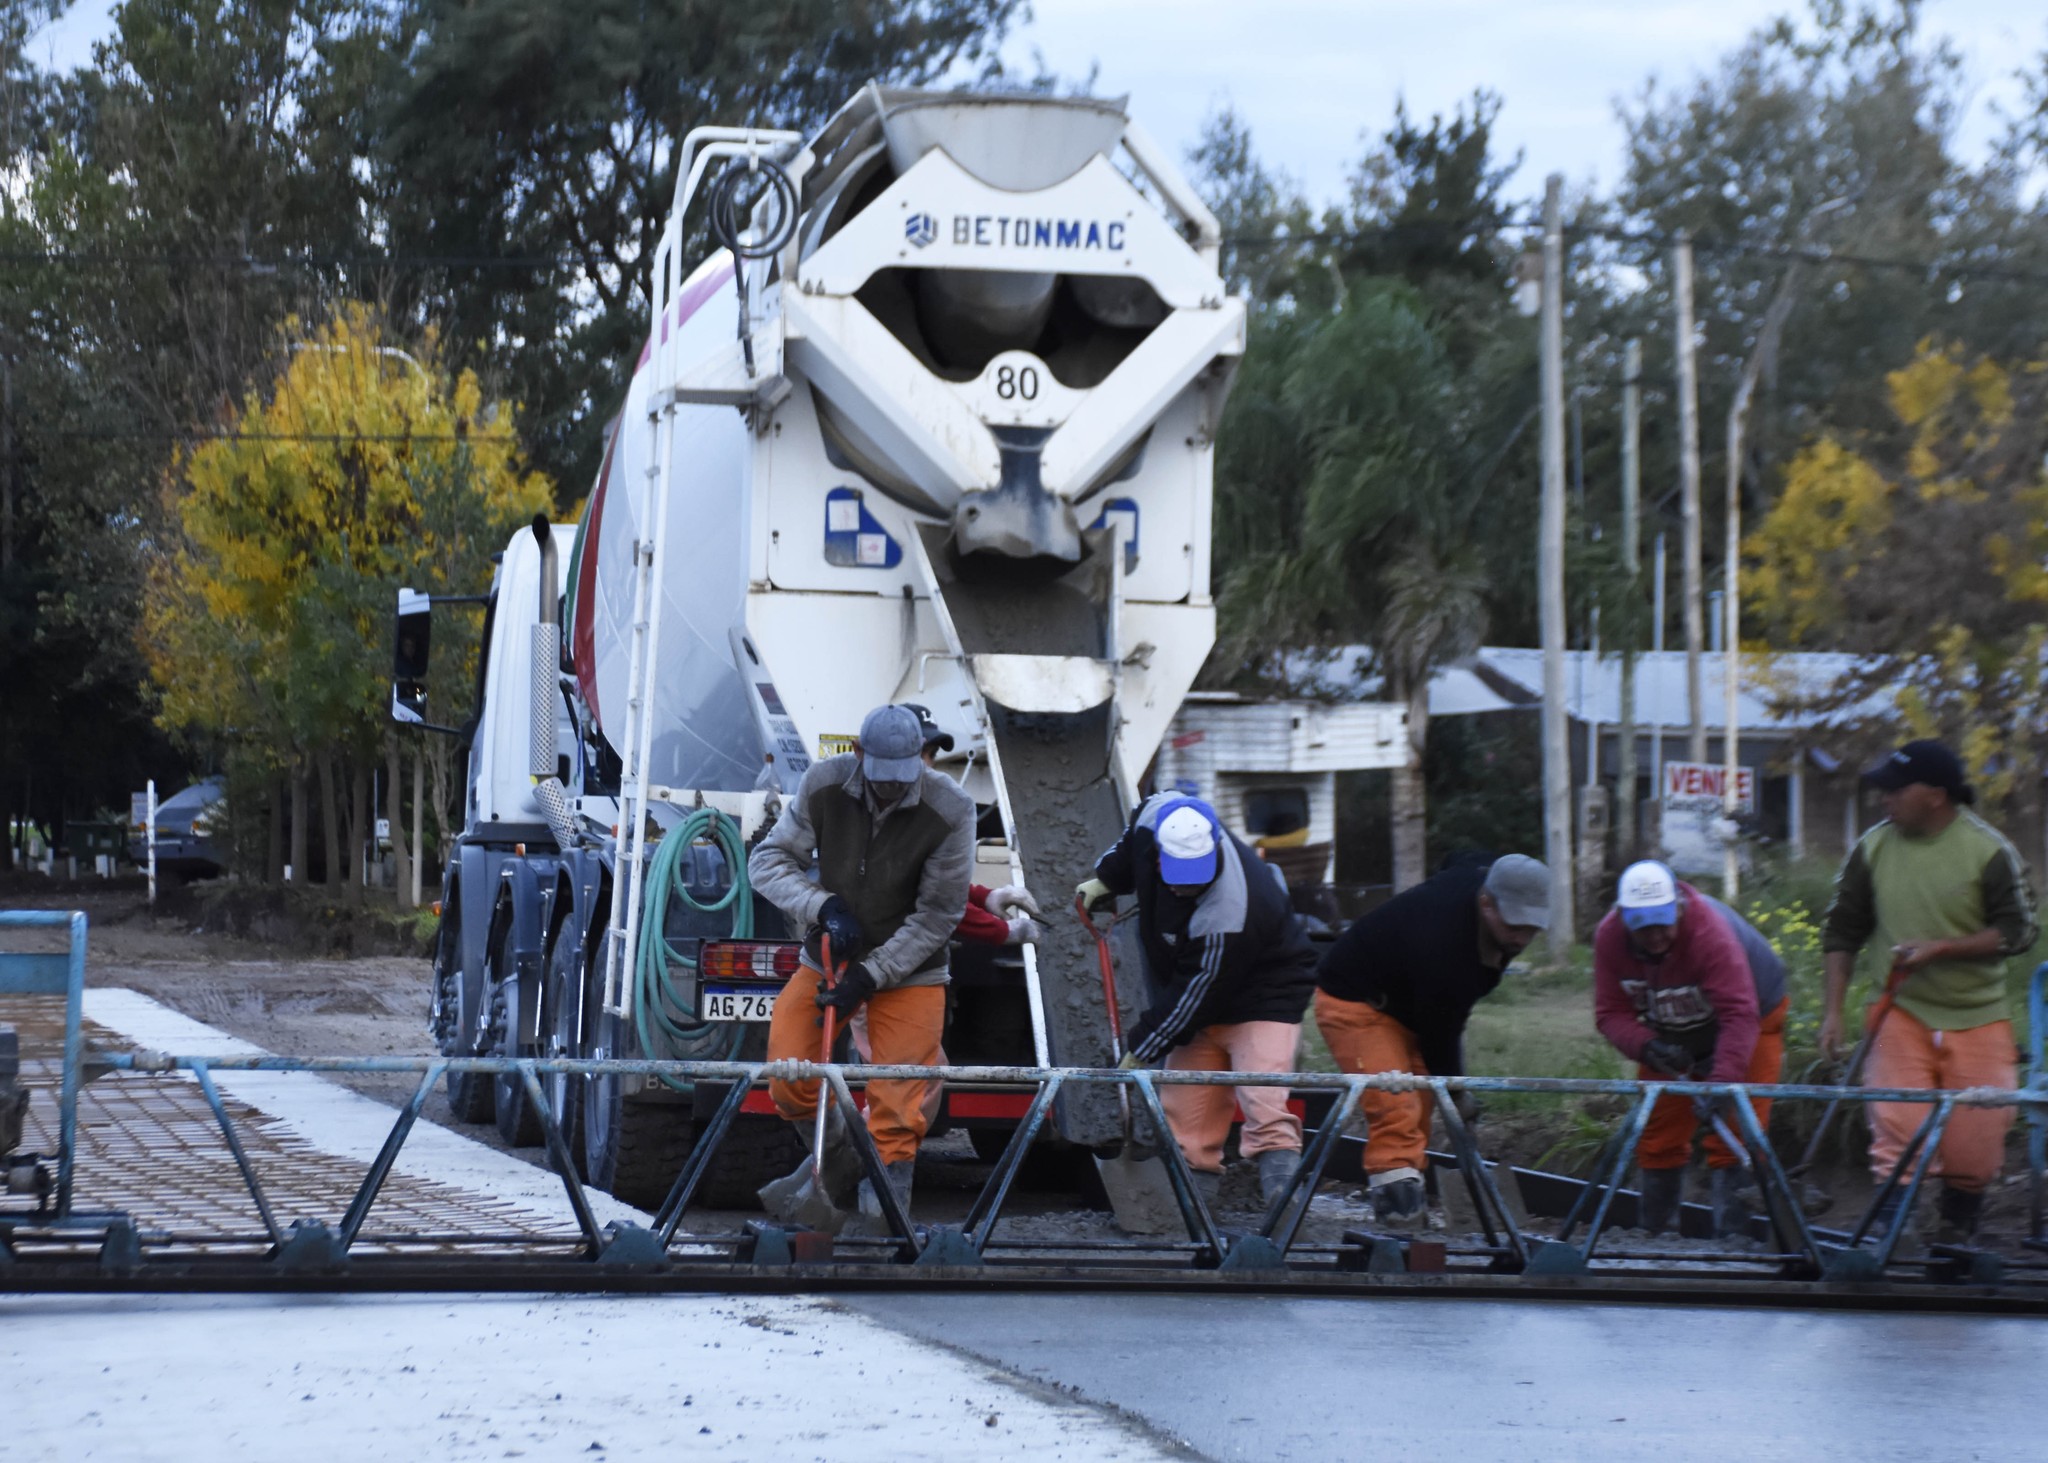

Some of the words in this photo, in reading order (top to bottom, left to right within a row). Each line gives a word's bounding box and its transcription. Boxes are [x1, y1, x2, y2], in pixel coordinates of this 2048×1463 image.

[952, 215, 1125, 251] BETONMAC
[996, 365, 1039, 401] 80
[709, 996, 735, 1017] AG
